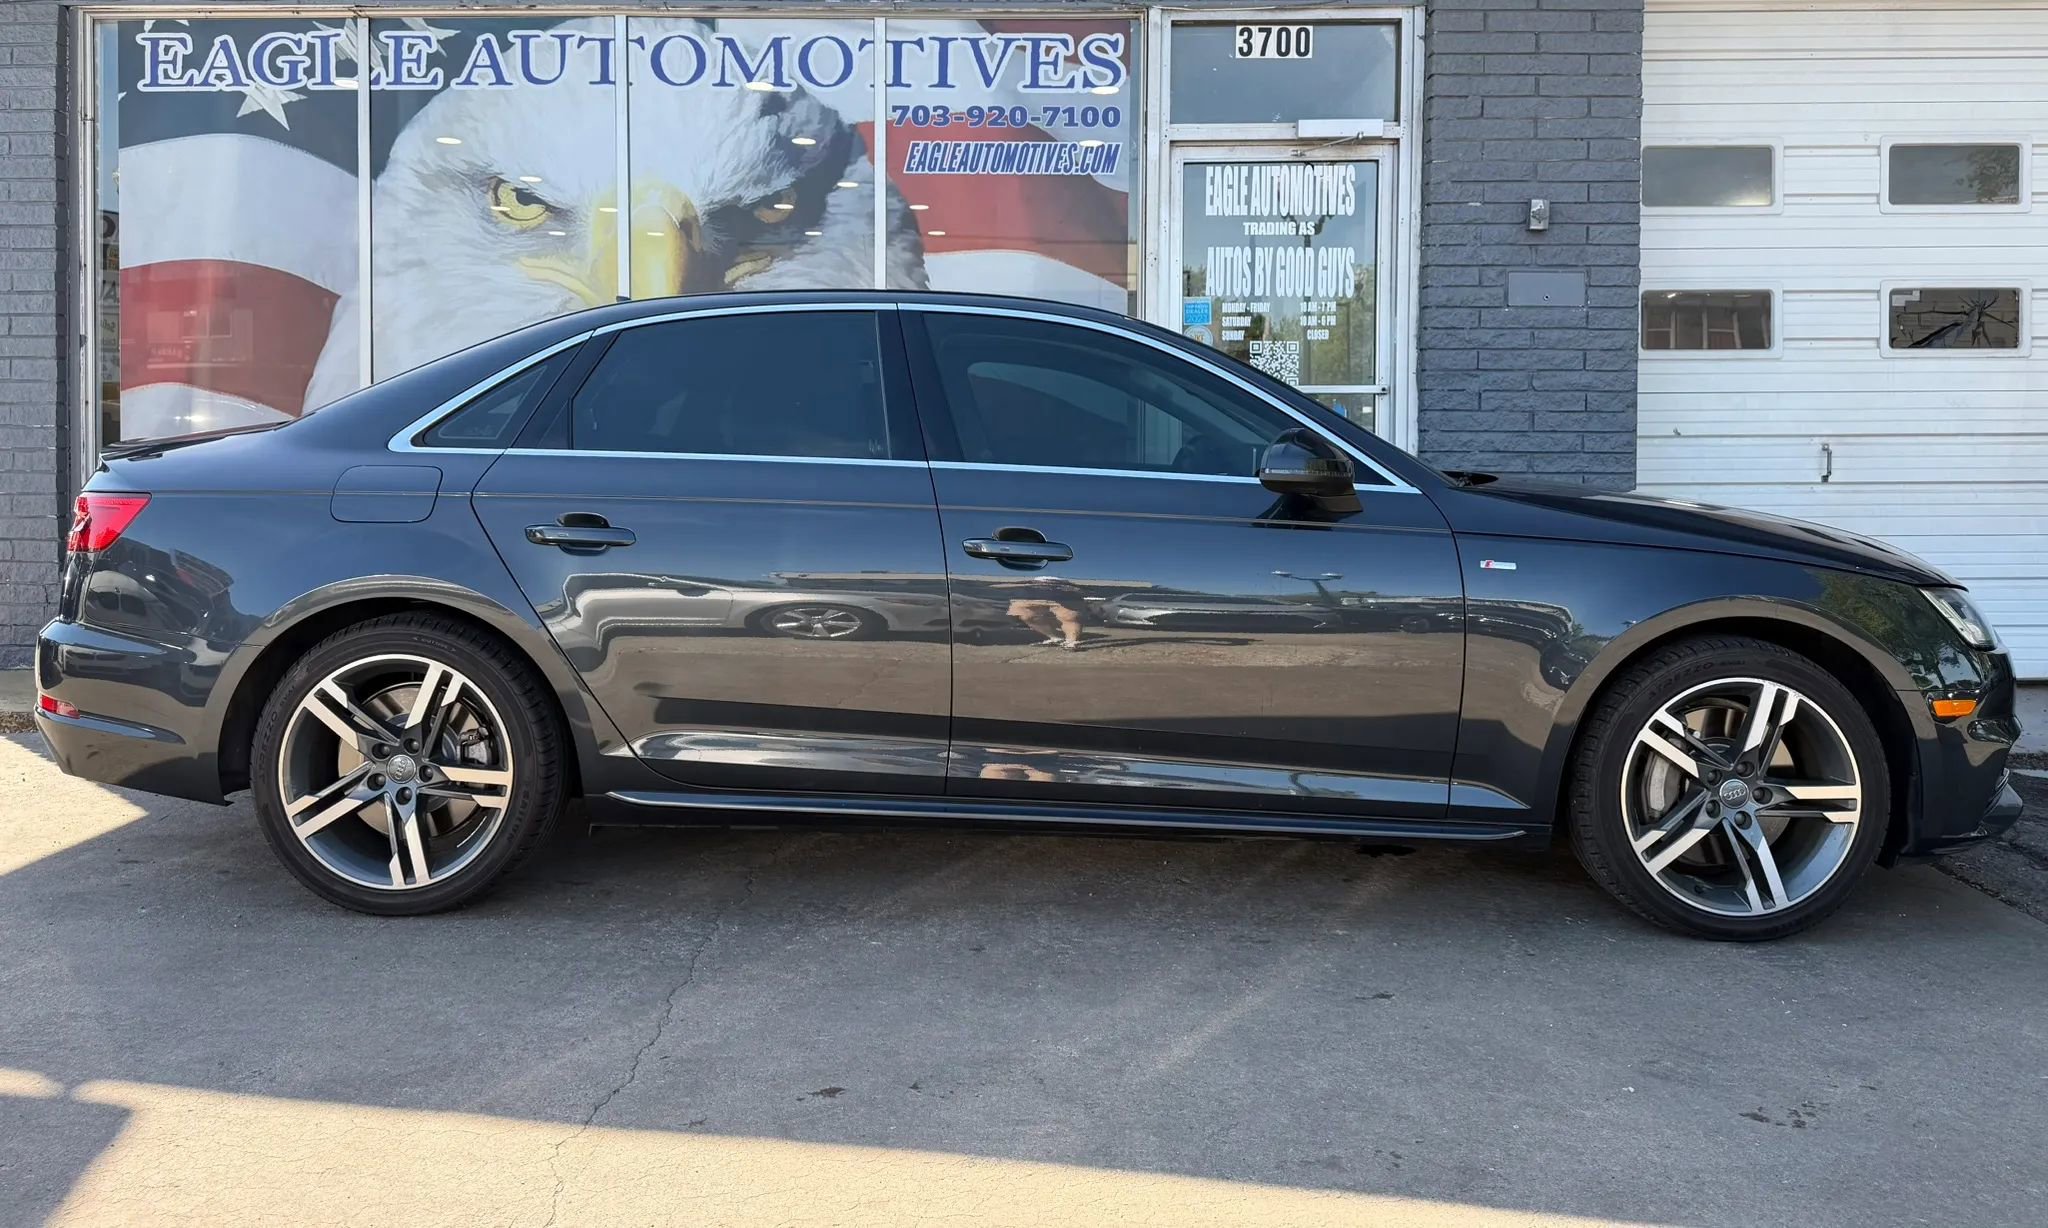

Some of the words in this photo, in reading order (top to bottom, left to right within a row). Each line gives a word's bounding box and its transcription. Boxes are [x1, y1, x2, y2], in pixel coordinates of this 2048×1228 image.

[1238, 26, 1311, 57] 3700
[136, 32, 443, 91] EAGLE
[453, 31, 1125, 92] AUTOMOTIVES
[891, 104, 1121, 128] 703-920-7100
[903, 140, 1122, 176] EAGLEAUTOMOTIVES.COM
[1205, 165, 1249, 216] EAGLE
[1250, 164, 1355, 216] AUTOMOTIVES
[1243, 221, 1296, 236] TRADING
[1299, 221, 1315, 236] AS
[1205, 246, 1251, 297] AUTOS
[1254, 247, 1273, 297] BY
[1275, 246, 1315, 297] GOOD
[1317, 246, 1355, 298] GUYS
[1222, 303, 1246, 313] MONDAY
[1250, 302, 1270, 313] FRIDAY
[1222, 316, 1251, 327] SATURDAY
